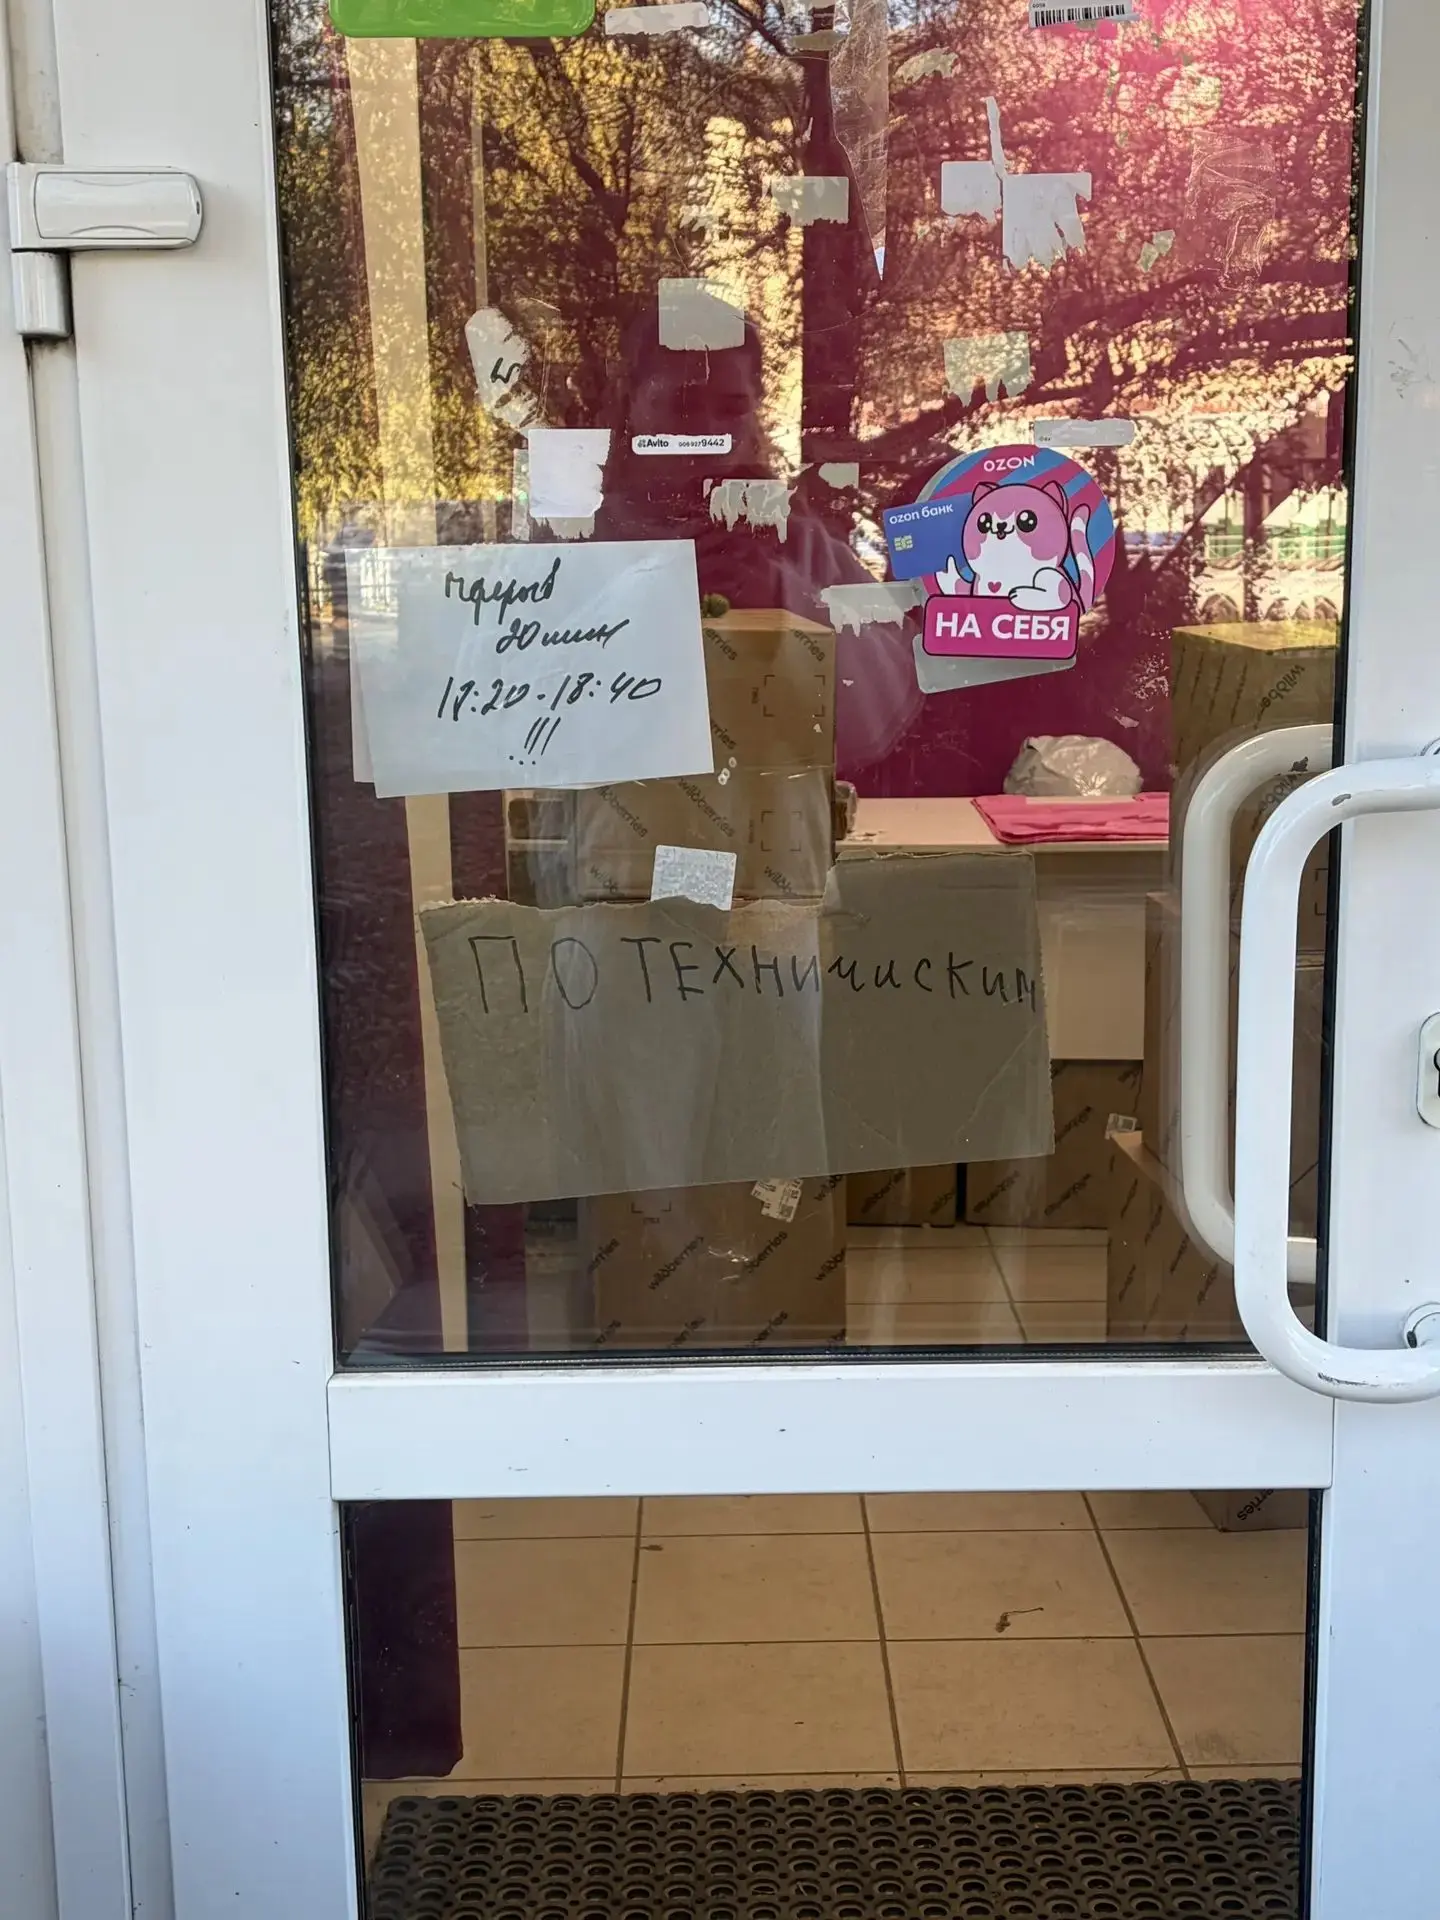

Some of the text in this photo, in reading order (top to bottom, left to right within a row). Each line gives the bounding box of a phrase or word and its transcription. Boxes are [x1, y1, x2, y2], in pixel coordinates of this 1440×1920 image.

[646, 438, 669, 448] Avito
[983, 455, 1035, 473] OZON
[889, 503, 954, 525] ozon банк
[935, 612, 1070, 641] НА СЕБЯ
[702, 627, 738, 661] erries
[467, 936, 598, 1014] ПО
